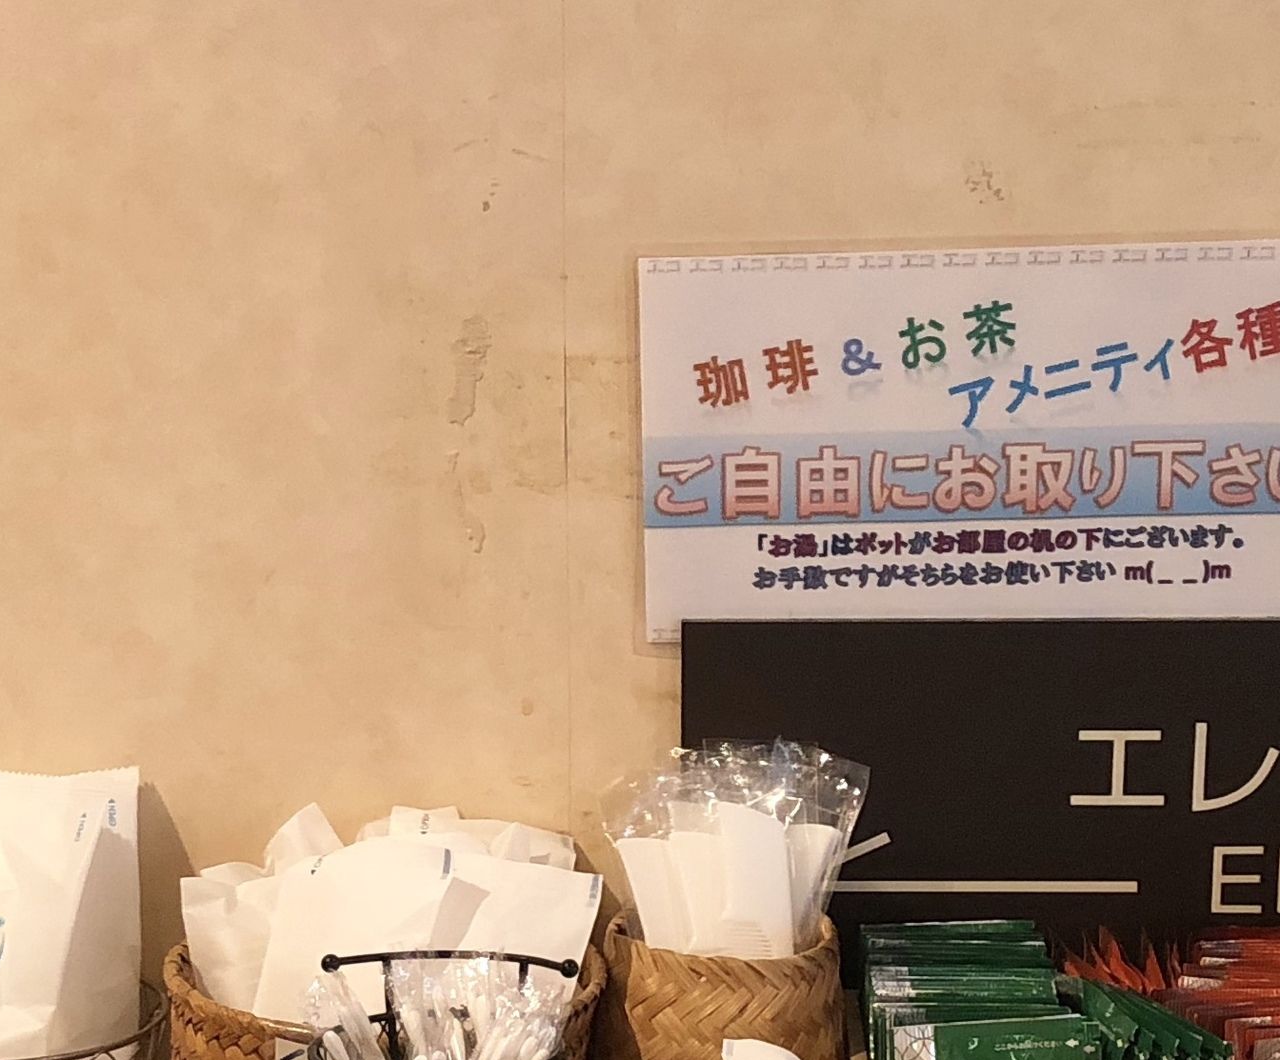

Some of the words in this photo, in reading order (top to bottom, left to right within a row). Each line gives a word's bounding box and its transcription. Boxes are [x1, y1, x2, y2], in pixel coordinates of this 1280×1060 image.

[693, 338, 820, 410] 珈琲
[840, 337, 883, 377] &
[897, 299, 1020, 370] お茶
